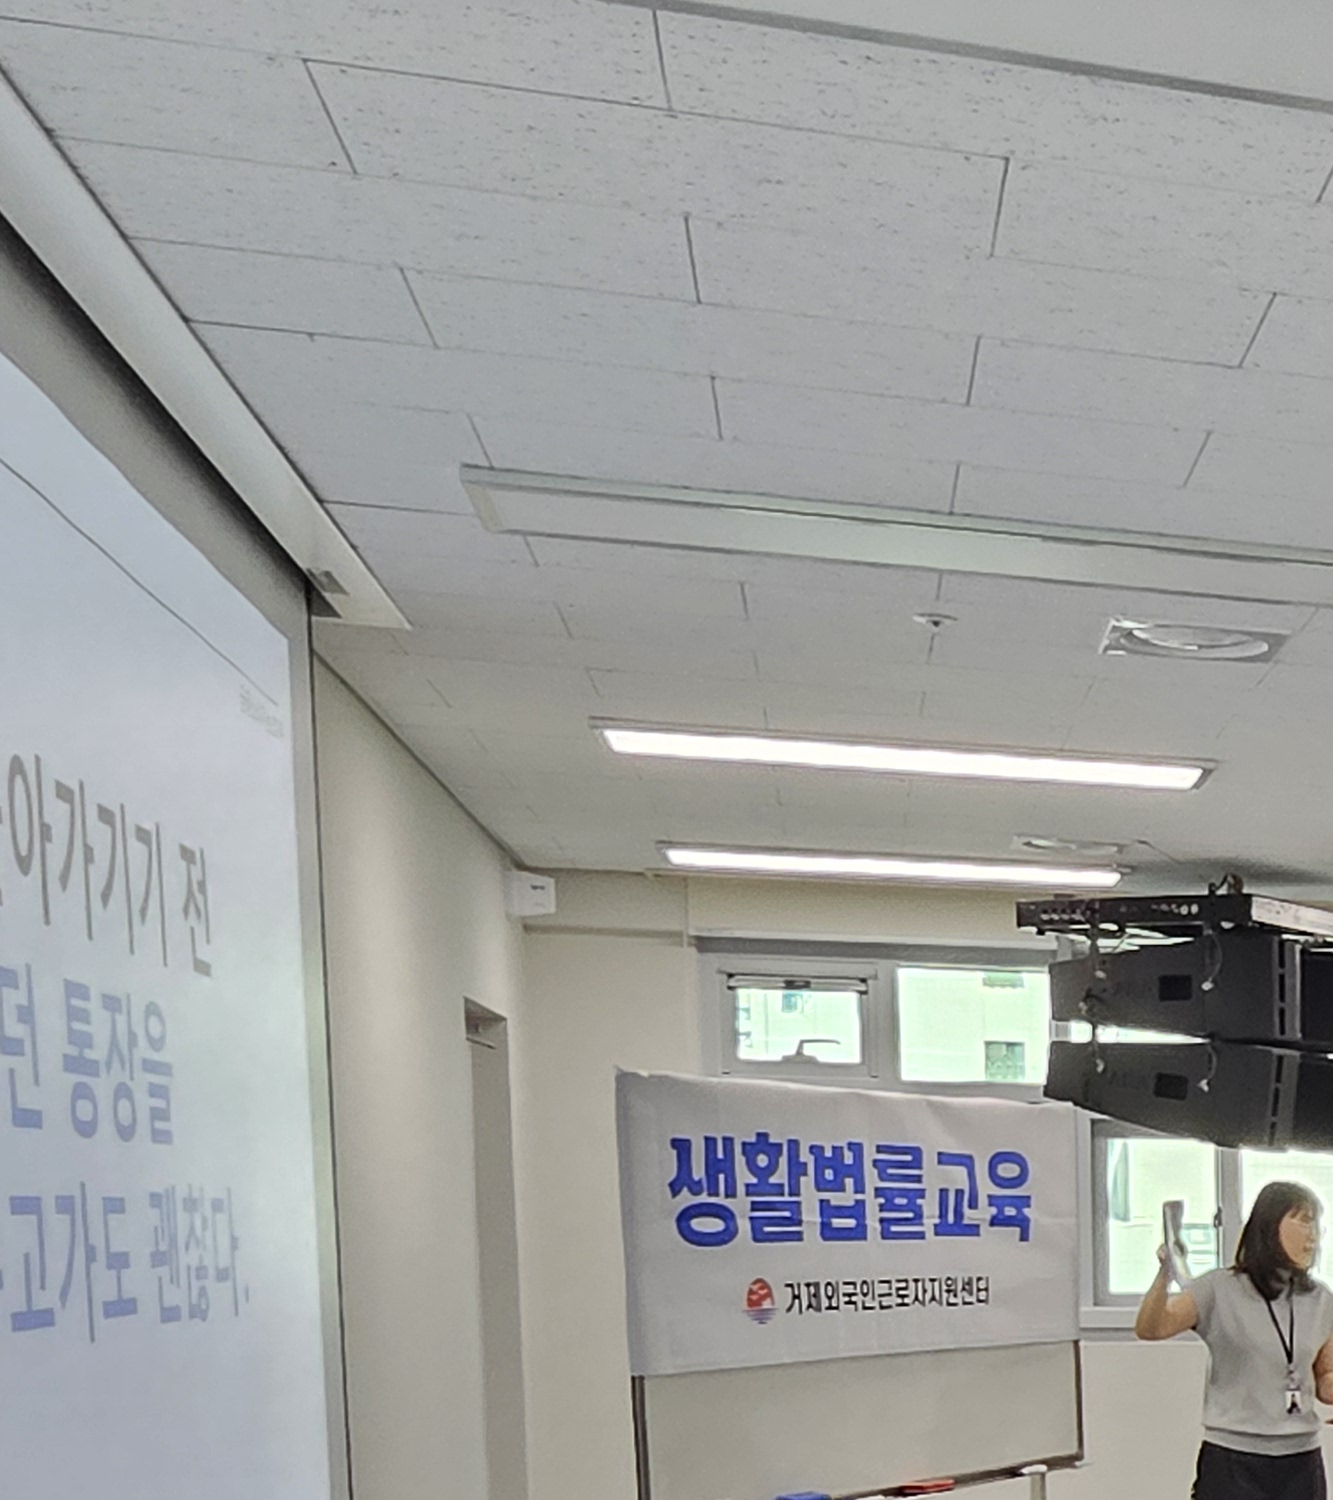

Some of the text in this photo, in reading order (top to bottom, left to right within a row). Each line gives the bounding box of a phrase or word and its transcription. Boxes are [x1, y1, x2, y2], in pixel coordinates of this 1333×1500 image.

[0, 753, 213, 979] 아가기기 전
[62, 977, 174, 1146] 통장을
[0, 1180, 139, 1345] 고가도
[668, 1131, 1032, 1247] 생활법률교육
[784, 1275, 990, 1315] 거제외국인근로자지원센터
